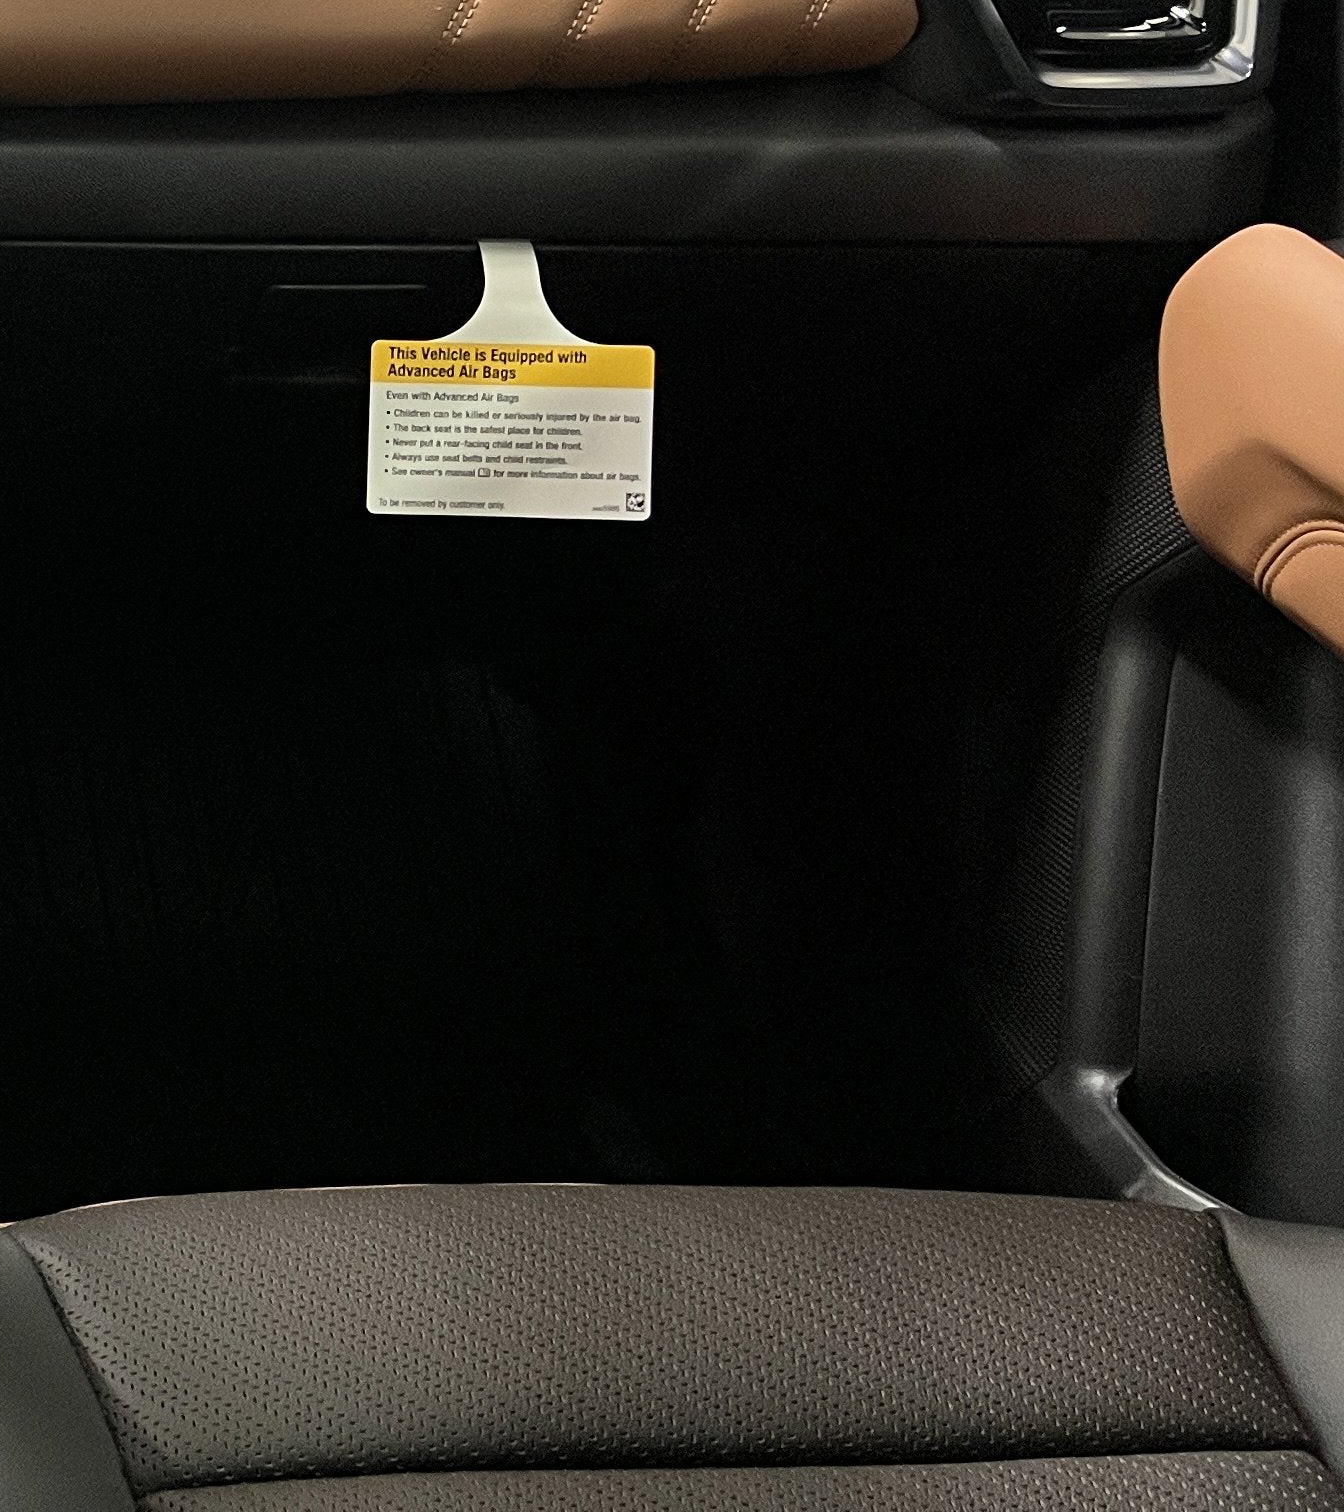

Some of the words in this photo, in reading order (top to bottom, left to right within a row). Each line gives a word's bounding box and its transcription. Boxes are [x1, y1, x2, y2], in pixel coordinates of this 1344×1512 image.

[388, 346, 417, 361] This
[422, 347, 471, 362] Vehicle
[475, 348, 487, 362] is
[490, 348, 554, 366] Equipped
[558, 350, 588, 364] with
[387, 364, 455, 378] Advanced
[459, 365, 479, 378] Air
[482, 366, 518, 382] Bags
[386, 390, 409, 400] Even
[412, 390, 432, 400] with
[433, 391, 479, 402] Advanced
[481, 392, 494, 402] Air
[496, 393, 520, 405] Bags
[394, 408, 431, 418] Children
[433, 410, 450, 418] can
[452, 410, 463, 419] be
[579, 413, 590, 423] by
[592, 414, 607, 422] the
[393, 423, 409, 432] The
[411, 424, 431, 433] back
[464, 426, 478, 434] the
[392, 438, 418, 447] Never
[391, 453, 422, 463] Always
[391, 467, 408, 476] See
[379, 498, 388, 507] To
[389, 499, 400, 507] be
[437, 500, 448, 510] by
